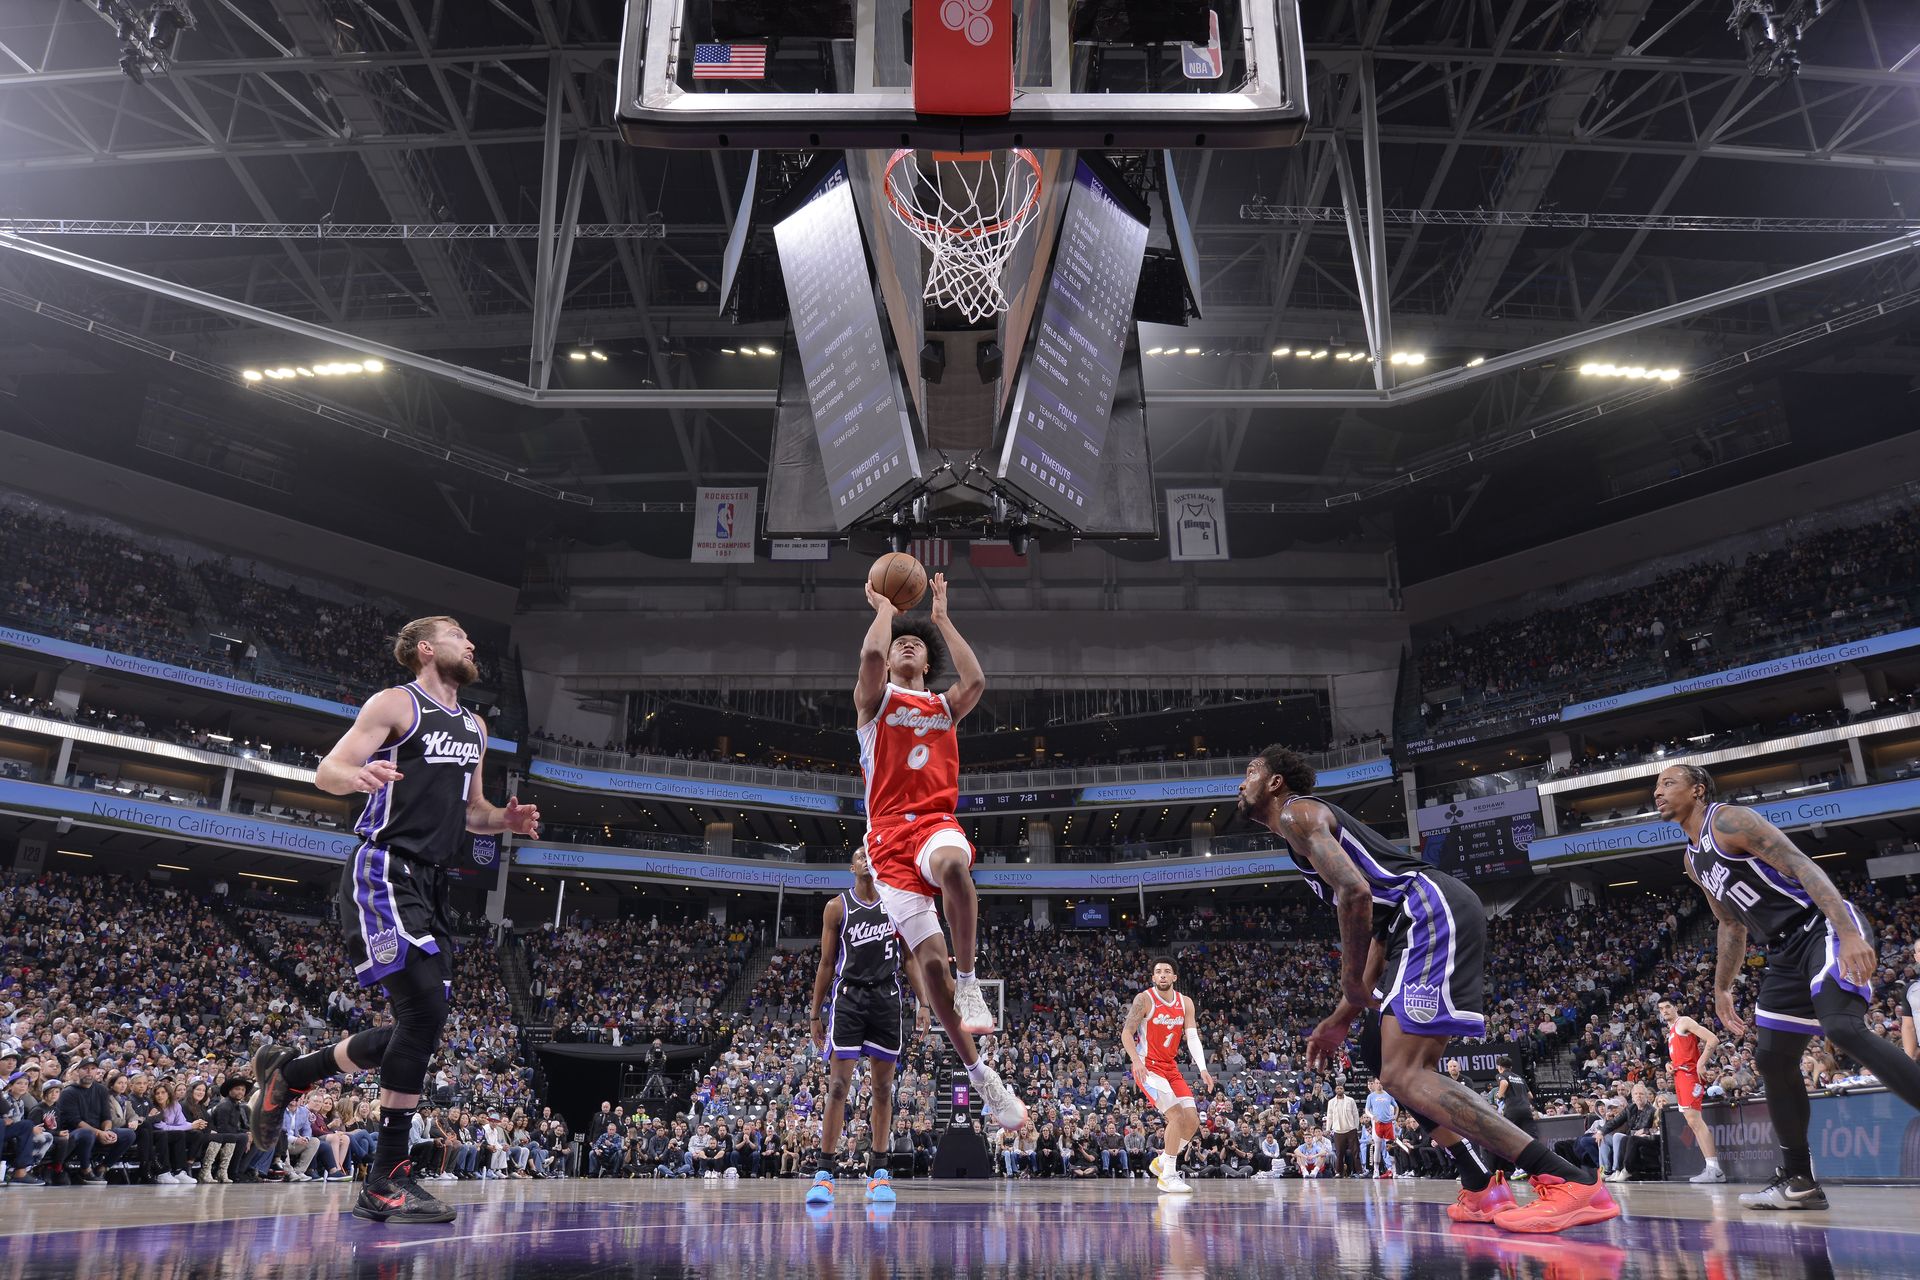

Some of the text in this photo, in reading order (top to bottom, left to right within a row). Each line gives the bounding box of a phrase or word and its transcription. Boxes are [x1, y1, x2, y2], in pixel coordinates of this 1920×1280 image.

[1189, 63, 1208, 74] NBA
[1076, 208, 1101, 238] IN-GAME
[1102, 193, 1136, 234] KINGS
[1077, 238, 1087, 252] FOX
[1080, 228, 1094, 246] MONK
[1074, 250, 1093, 273] DEROZAN
[1068, 274, 1082, 291] ELLIS
[1071, 262, 1091, 285] SABONIS
[1059, 285, 1070, 301] TEAM
[825, 326, 853, 357] SHOOTING
[1042, 322, 1057, 339] FIELD
[1057, 334, 1072, 353] GOALS
[1068, 326, 1098, 358] SHOOTING
[1040, 338, 1068, 366] 3-POINTERS
[809, 373, 821, 389] FIELD
[820, 362, 835, 379] GOALS
[1036, 354, 1049, 370] FREE
[1048, 366, 1069, 386] THROWS
[812, 379, 837, 404] 3-POINTERS
[815, 403, 827, 419] FREE
[826, 391, 844, 411] THROWS
[844, 403, 863, 424] FOULS
[875, 396, 892, 414] BONUS
[1058, 402, 1078, 424] FOULS
[1039, 405, 1067, 432] TEAM FOULS
[833, 423, 860, 448] TEAM FOULS
[1083, 440, 1099, 457] BONUS
[851, 452, 880, 480] TIMEOUTS
[1041, 451, 1071, 480] TIMEOUTS
[1174, 494, 1216, 504] SIXTH MAN
[1184, 520, 1210, 530] Kings
[1202, 532, 1208, 540] 6
[0, 630, 41, 645] ENTIVO
[106, 654, 292, 704] Northern California's Hidden Gem
[1673, 644, 1869, 694] Northern California's Hidden Gem
[1583, 699, 1618, 711] SENTIVO
[886, 706, 952, 736] Memphis
[1548, 713, 1560, 722] PM
[421, 731, 480, 766] Kings
[1406, 740, 1425, 749] PIPPEN
[1436, 740, 1456, 749] JAYLEN
[907, 744, 929, 770] 0
[545, 767, 583, 780] SENTIVO
[1346, 766, 1383, 779] SENTIVO
[610, 778, 763, 800] Northern California's Hidden Gem
[1097, 788, 1136, 798] SENTIVO
[1162, 786, 1203, 796] Northern
[790, 795, 826, 805] SENTIVO
[1474, 801, 1505, 811] REDHAWK
[1478, 820, 1495, 828] STATS
[1512, 813, 1531, 821] KINGS
[91, 801, 351, 855] Northern California's Hidden Ge
[1422, 828, 1450, 837] GRIZZLIES
[1564, 835, 1632, 856] Northern
[1798, 803, 1841, 818] Gem
[543, 852, 584, 862] SENTIVO
[646, 861, 830, 885] Northern California's Hidden Gem
[1090, 862, 1274, 884] Northern California's Hidden Gem
[1726, 880, 1761, 912] 10
[1083, 912, 1101, 920] Corona
[848, 921, 893, 941] Kings
[373, 940, 397, 954] KINGS
[884, 940, 893, 960] 5
[1406, 998, 1437, 1009] KINGS
[1163, 1033, 1174, 1048] 1
[1740, 1150, 1773, 1160] emotion
